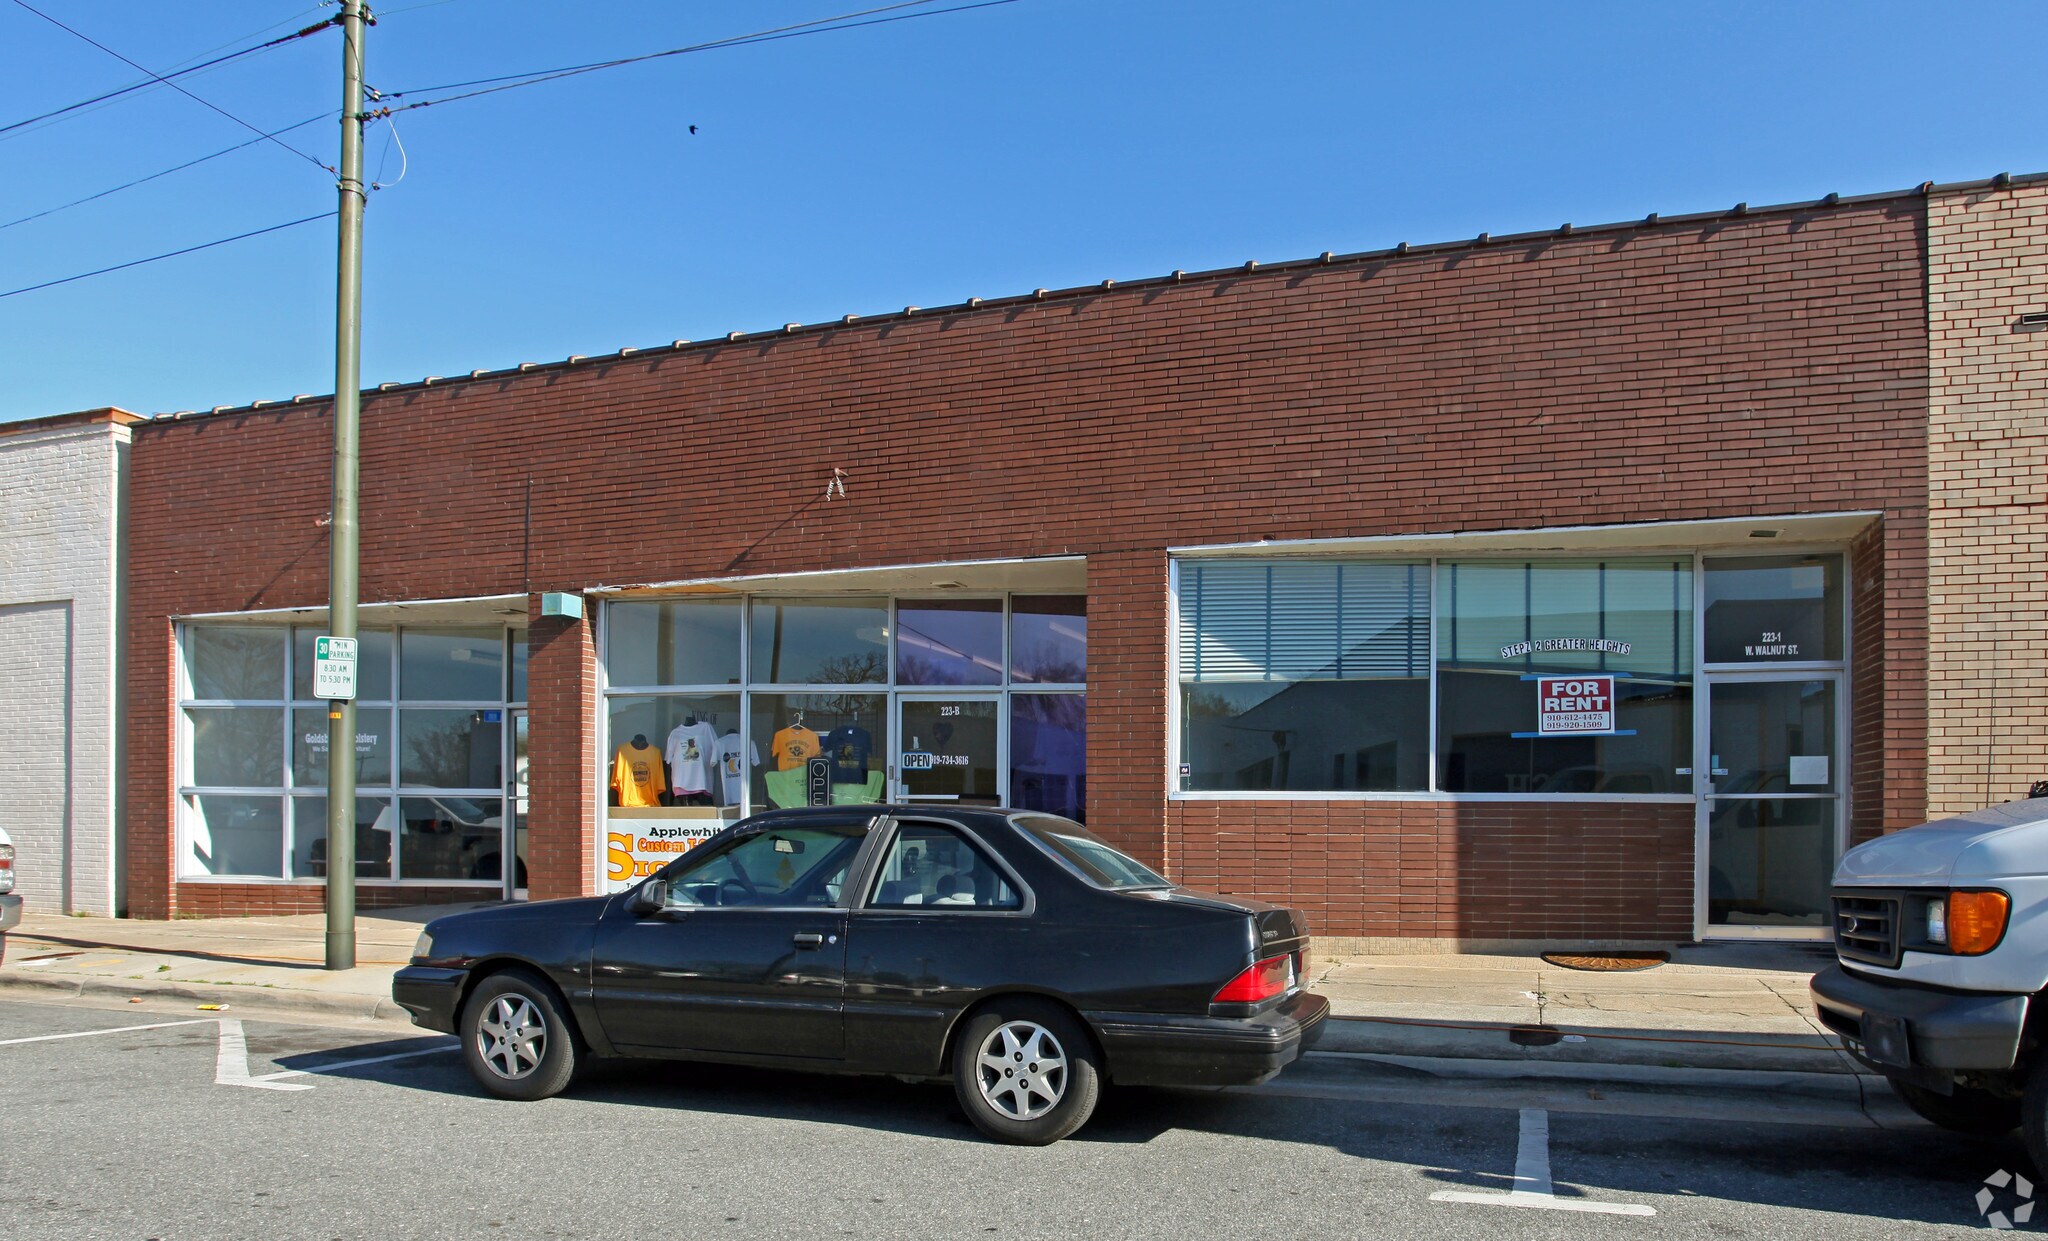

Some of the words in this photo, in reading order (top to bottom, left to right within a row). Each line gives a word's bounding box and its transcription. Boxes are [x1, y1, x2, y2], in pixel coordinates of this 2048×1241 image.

[1762, 631, 1781, 642] 223-1
[319, 642, 328, 654] 30
[336, 641, 348, 649] MIN
[1502, 641, 1531, 658] STEPZ
[1535, 640, 1542, 651] 2
[1545, 638, 1585, 650] GREATER
[1589, 639, 1631, 655] HEIGHTS
[1744, 645, 1754, 656] W.
[1755, 644, 1787, 656] WALNUT
[1787, 644, 1799, 655] ST.
[329, 650, 354, 659] PARKING
[338, 664, 347, 673] AM
[320, 674, 327, 683] TO
[342, 675, 351, 684] PM
[1551, 681, 1600, 696] FOR
[1544, 696, 1608, 712] RENT
[940, 705, 960, 716] 223-B
[1546, 713, 1603, 722] 910-612-4475
[1546, 721, 1602, 729] 919-920-1509
[904, 754, 930, 768] OPEN
[638, 838, 686, 852] Custom
